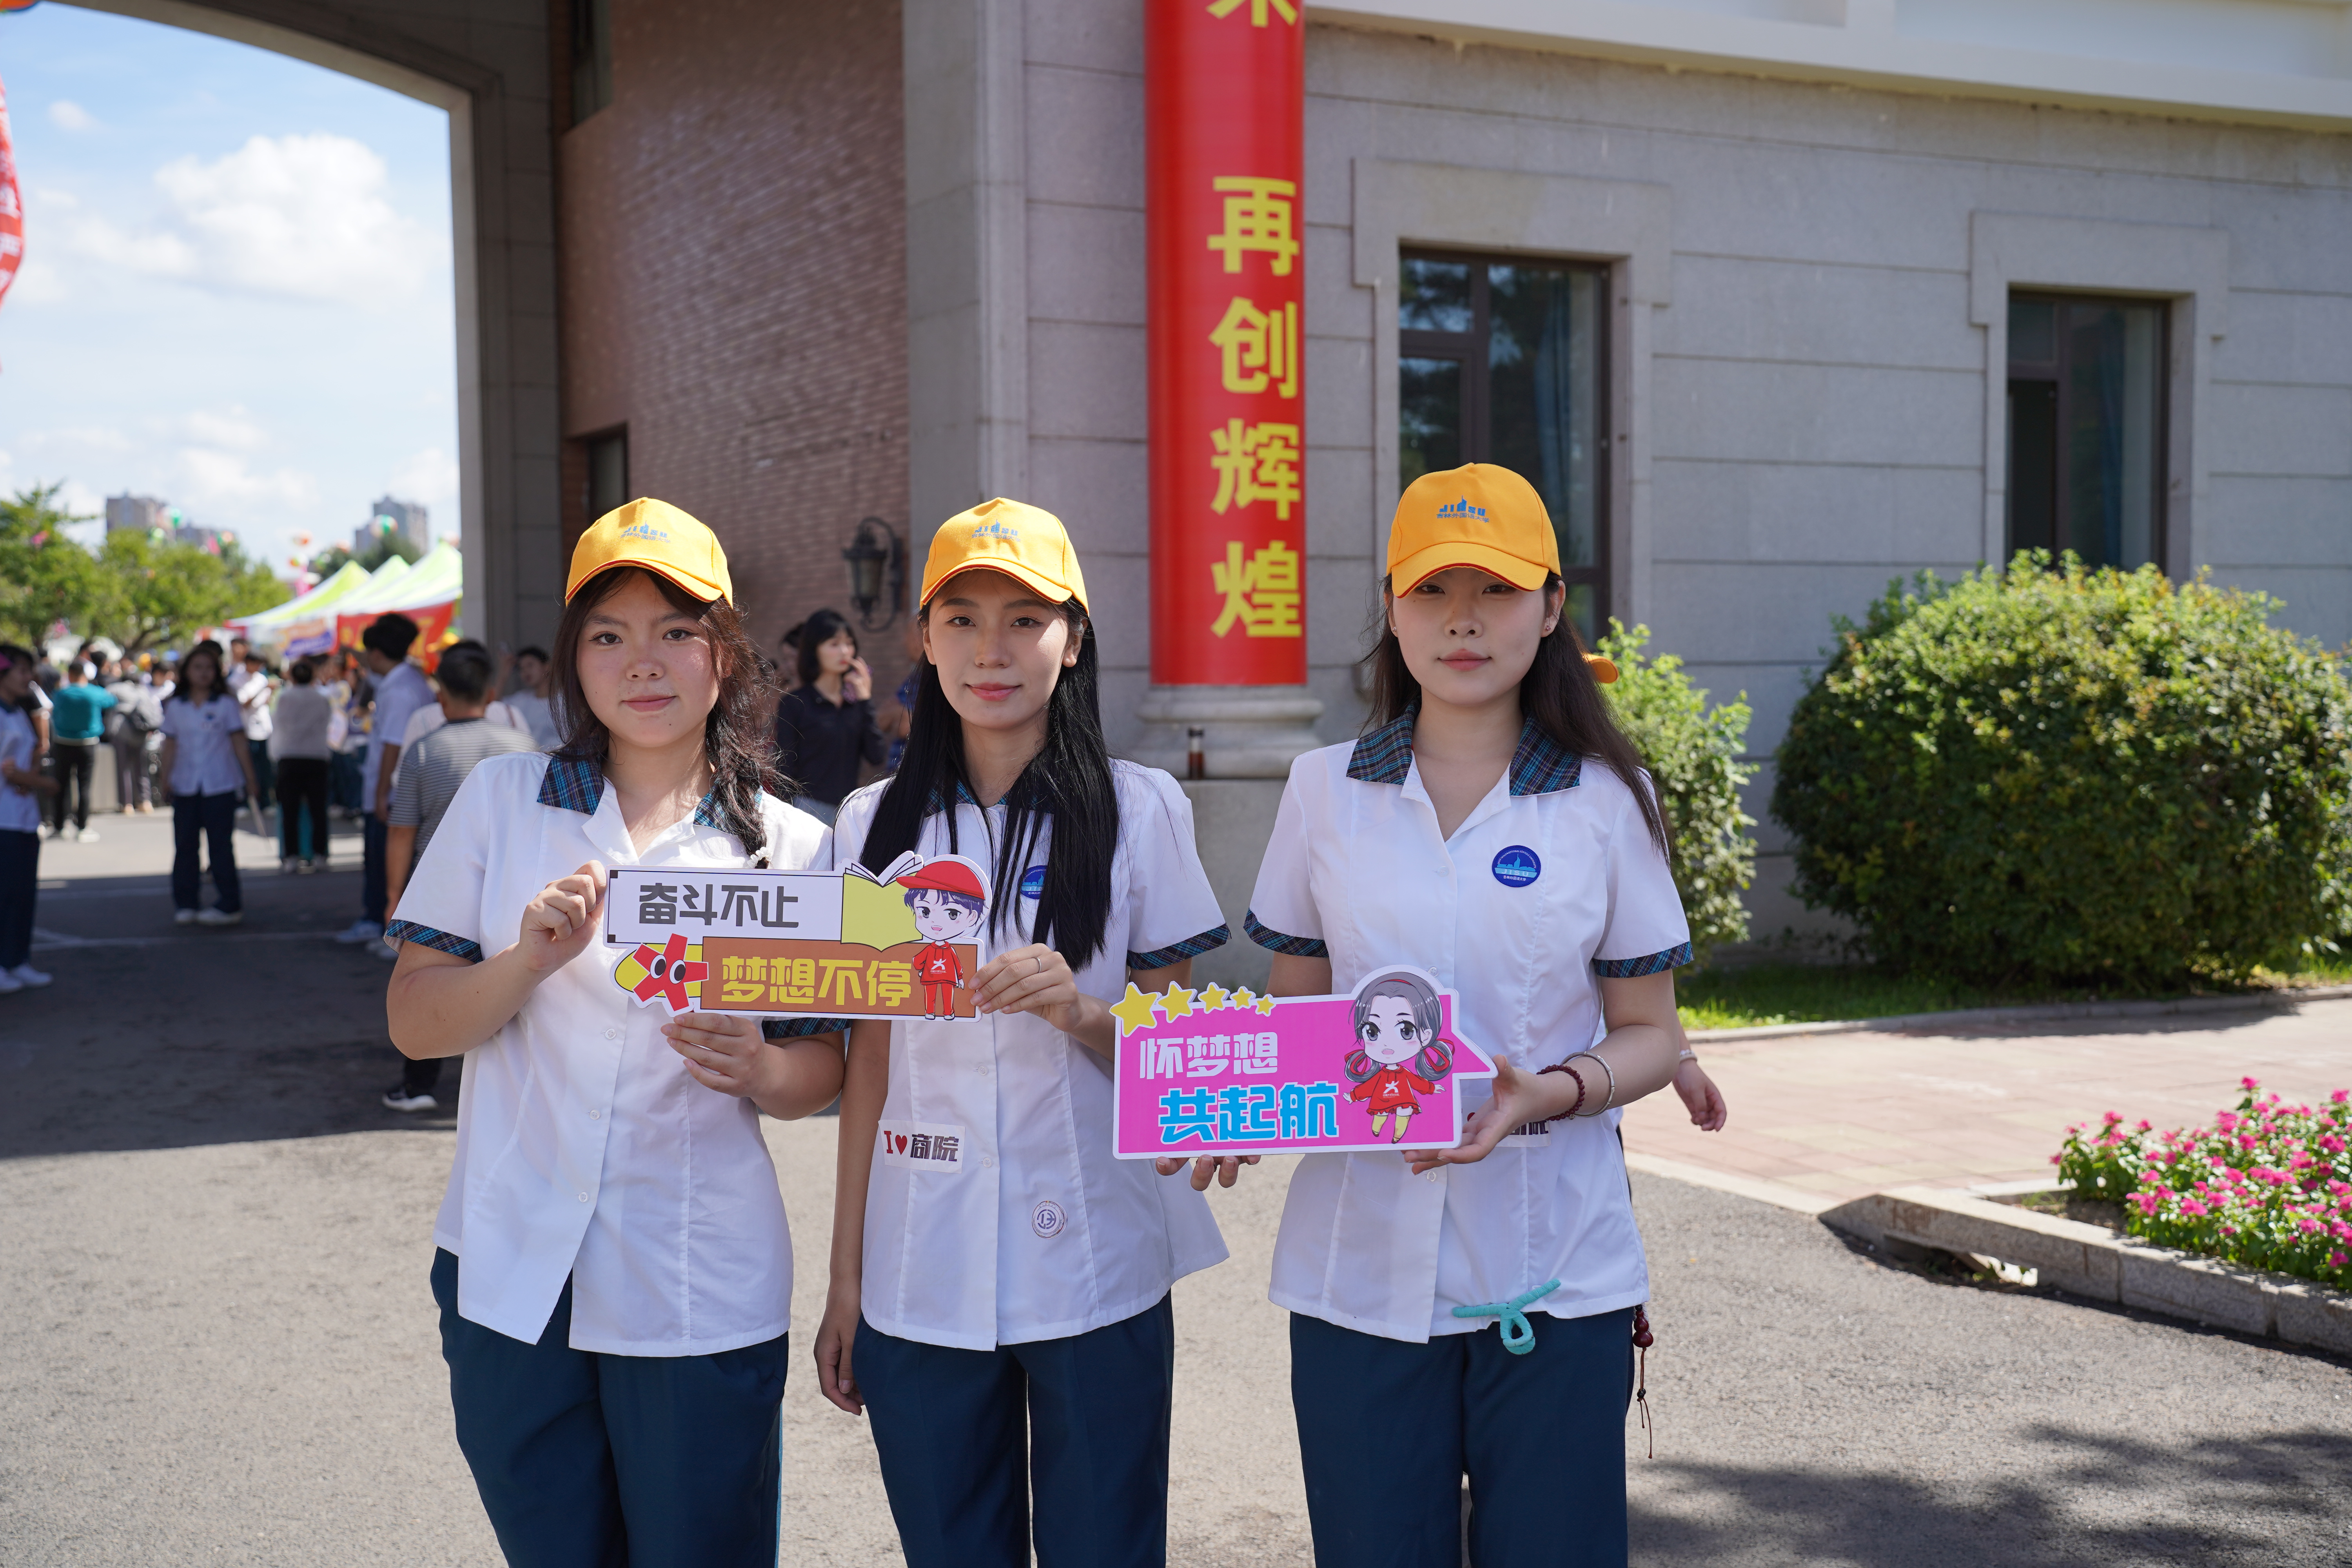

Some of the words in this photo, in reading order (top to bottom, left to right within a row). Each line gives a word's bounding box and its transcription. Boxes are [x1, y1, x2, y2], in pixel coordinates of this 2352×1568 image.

[1207, 176, 1302, 638] 再创辉煌
[1436, 512, 1490, 523] 吉林外国语大学
[639, 882, 799, 928] 奋斗不止
[721, 956, 912, 1007] 梦想不停
[1140, 1031, 1278, 1080] 怀梦想
[1158, 1080, 1339, 1145] 共起航
